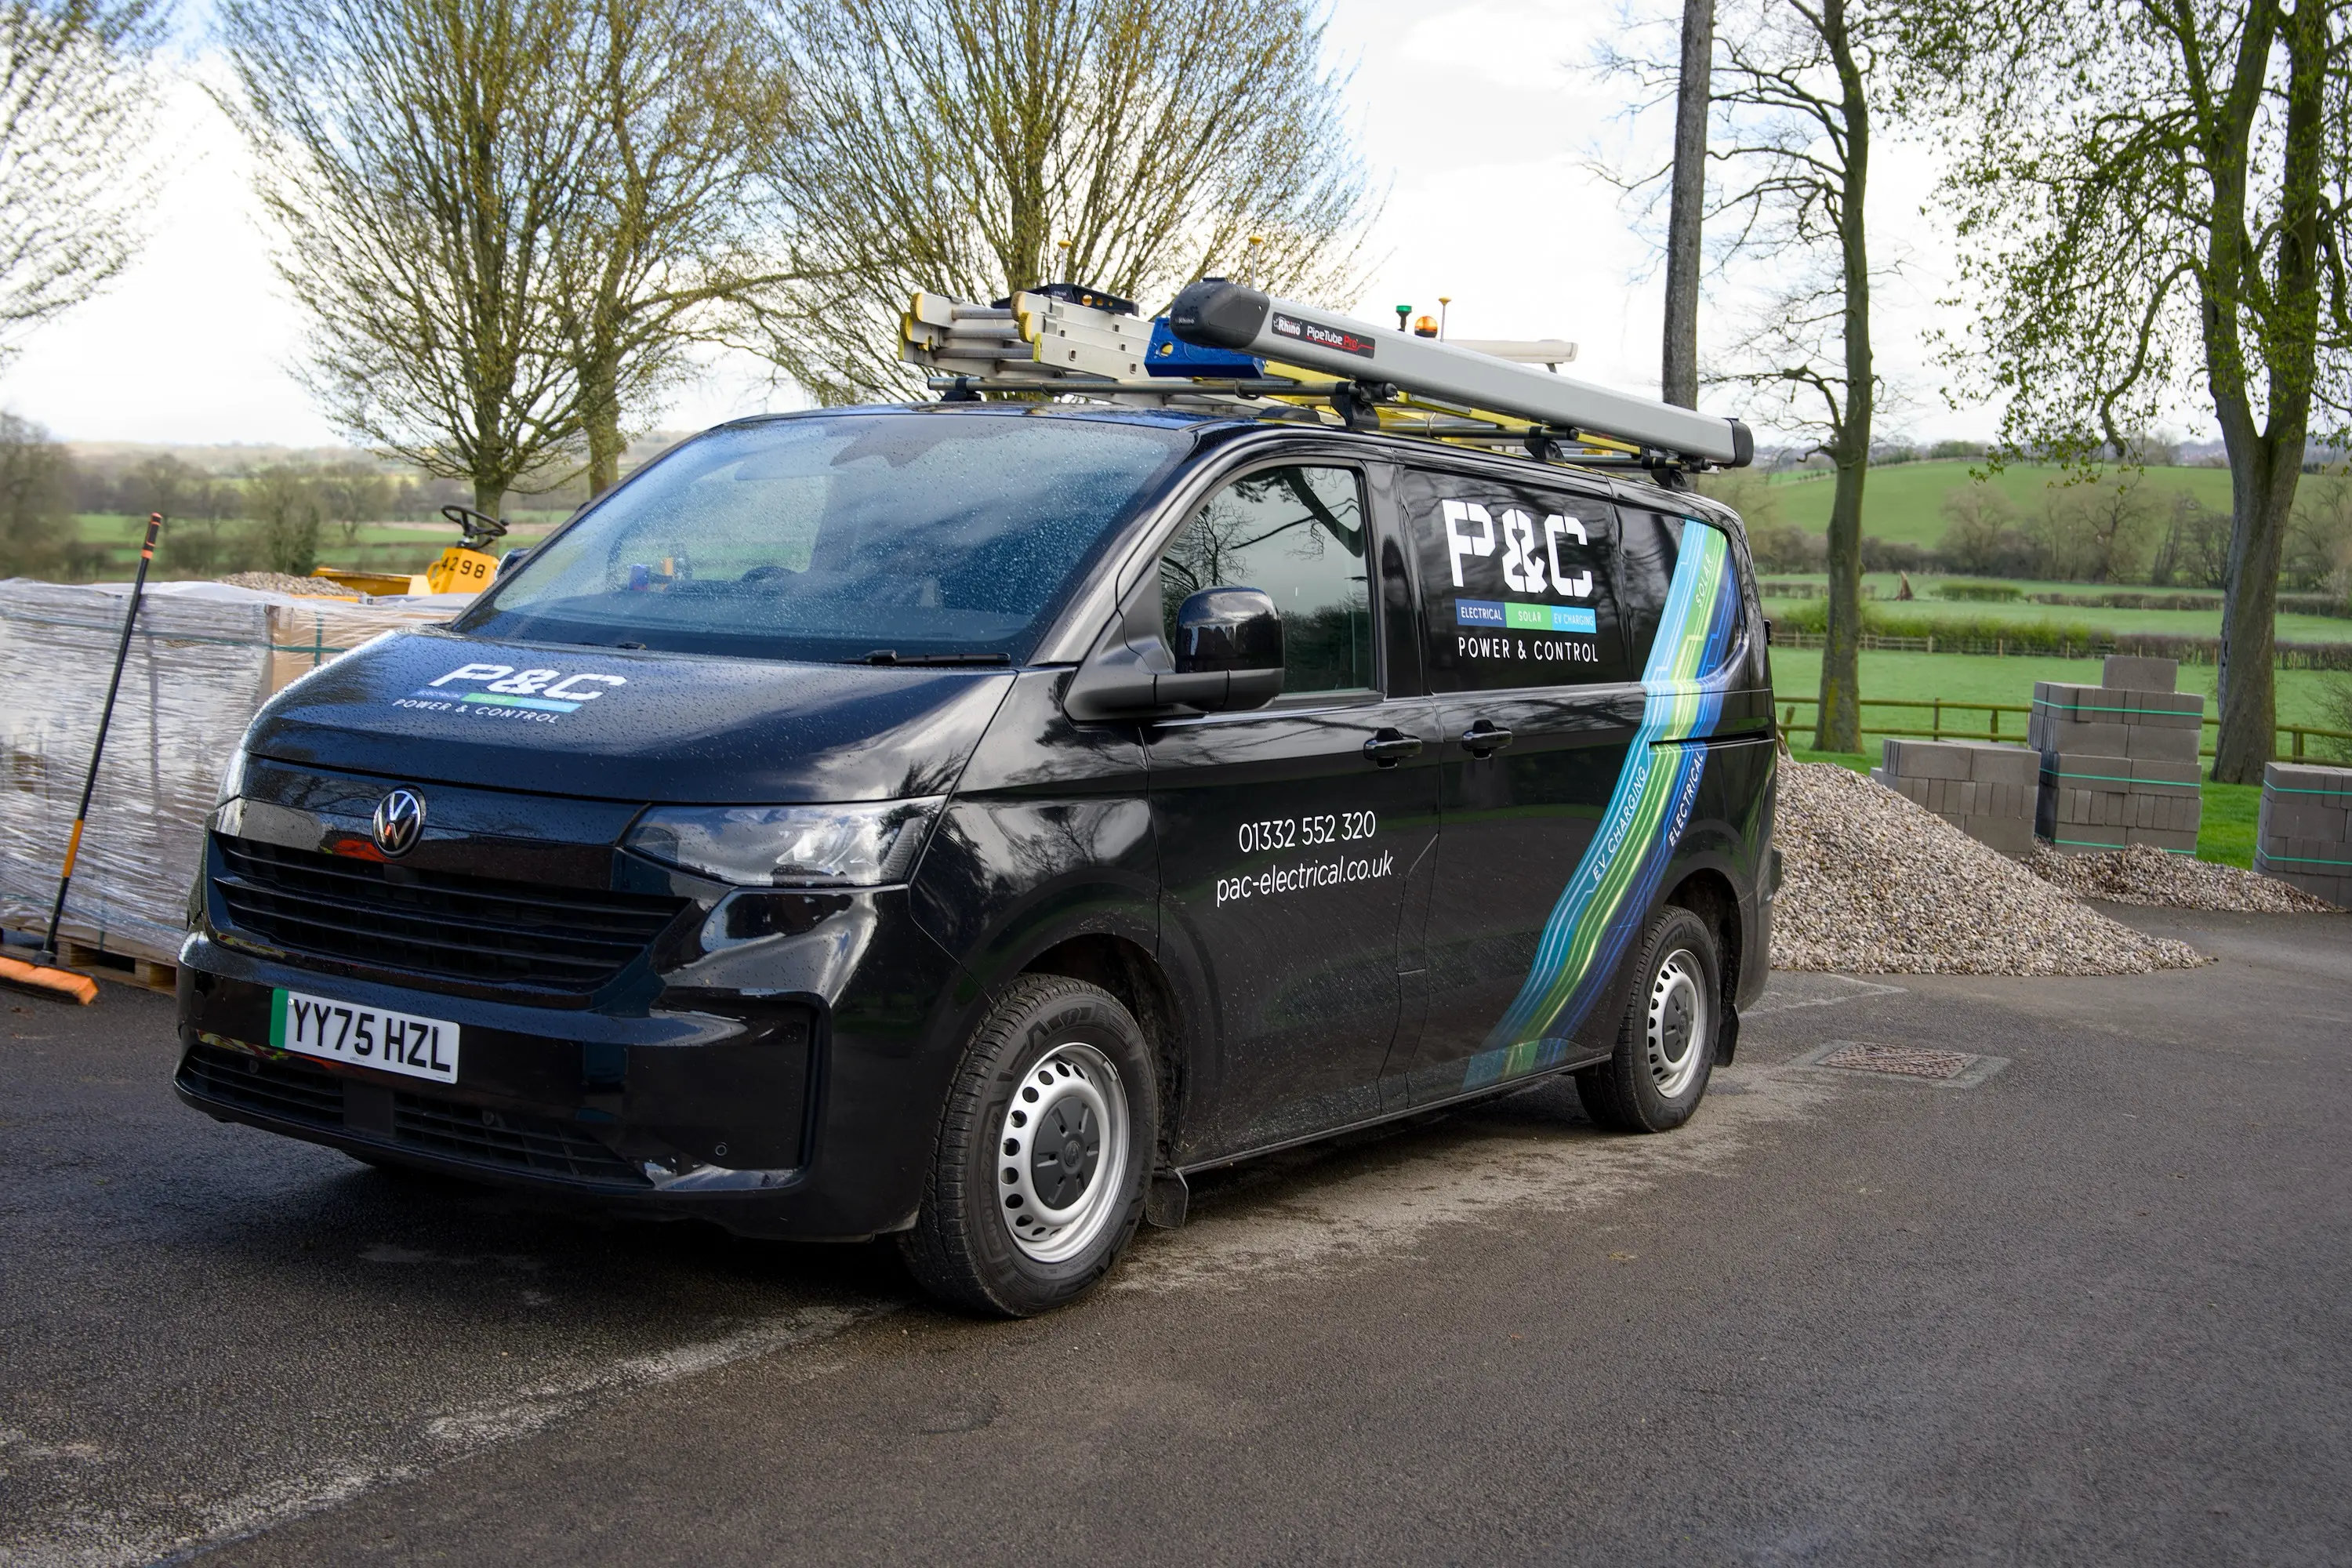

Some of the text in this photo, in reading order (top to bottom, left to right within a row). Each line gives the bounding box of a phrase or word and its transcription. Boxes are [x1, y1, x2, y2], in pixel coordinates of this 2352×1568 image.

[1278, 318, 1357, 349] Rhino PipeTube Pro
[440, 556, 486, 579] 4298
[1441, 499, 1593, 598] P&C
[1695, 552, 1712, 608] SOLAR
[1461, 606, 1503, 621] ELECTRICAL
[1518, 610, 1542, 623] SOLAR
[1553, 612, 1595, 626] EV CHARGING
[1457, 636, 1599, 662] POWER & CONTROL
[428, 662, 627, 700] P&C
[392, 699, 560, 724] POWER & CONTROL
[1668, 751, 1704, 848] ELECTRICAL
[1239, 810, 1376, 853] 01332 552 320
[1592, 765, 1646, 881] EV CHARGING
[1217, 849, 1394, 908] pac-electrical.co.uk
[293, 999, 451, 1073] YY75 HZL
